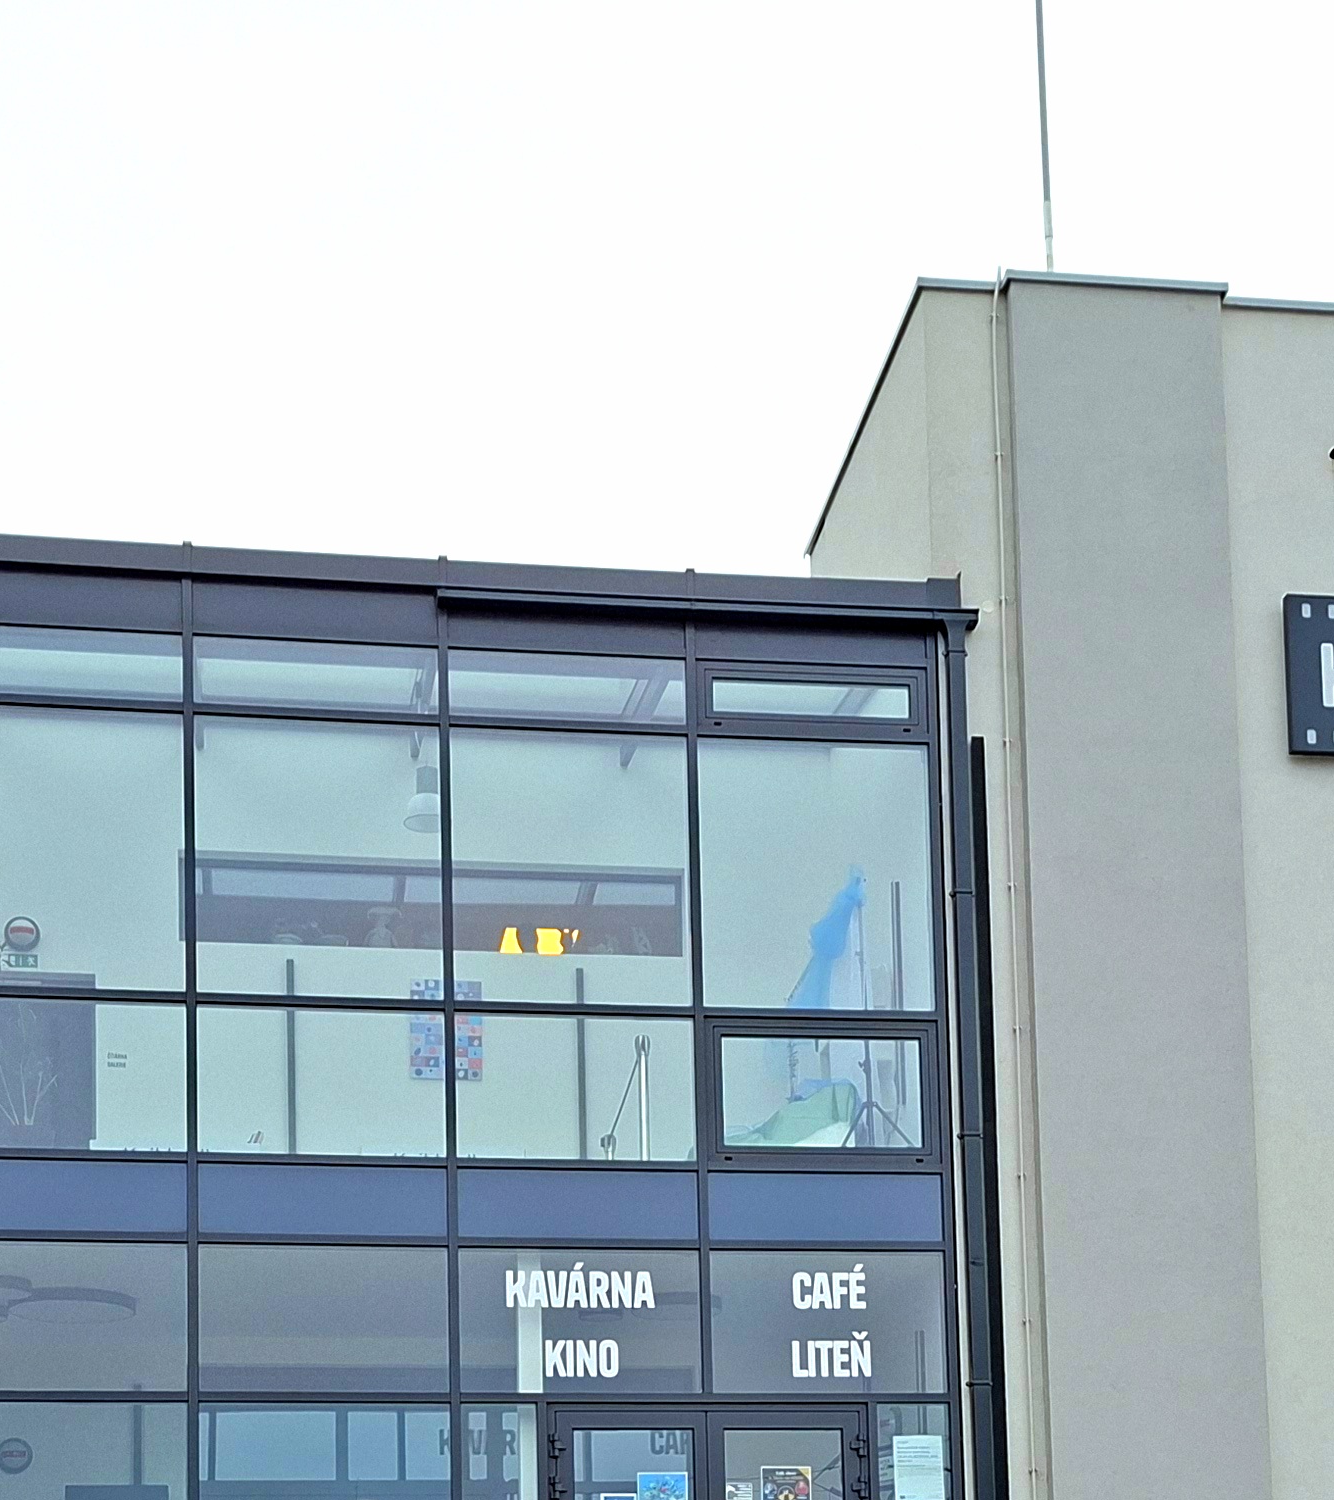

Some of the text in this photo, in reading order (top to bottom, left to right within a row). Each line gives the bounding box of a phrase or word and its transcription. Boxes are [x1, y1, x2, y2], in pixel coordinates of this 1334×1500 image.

[505, 1261, 656, 1310] KAVÁRNA
[791, 1263, 868, 1310] CAFÉ
[544, 1338, 619, 1378] KINO
[791, 1330, 872, 1378] LITEŇ
